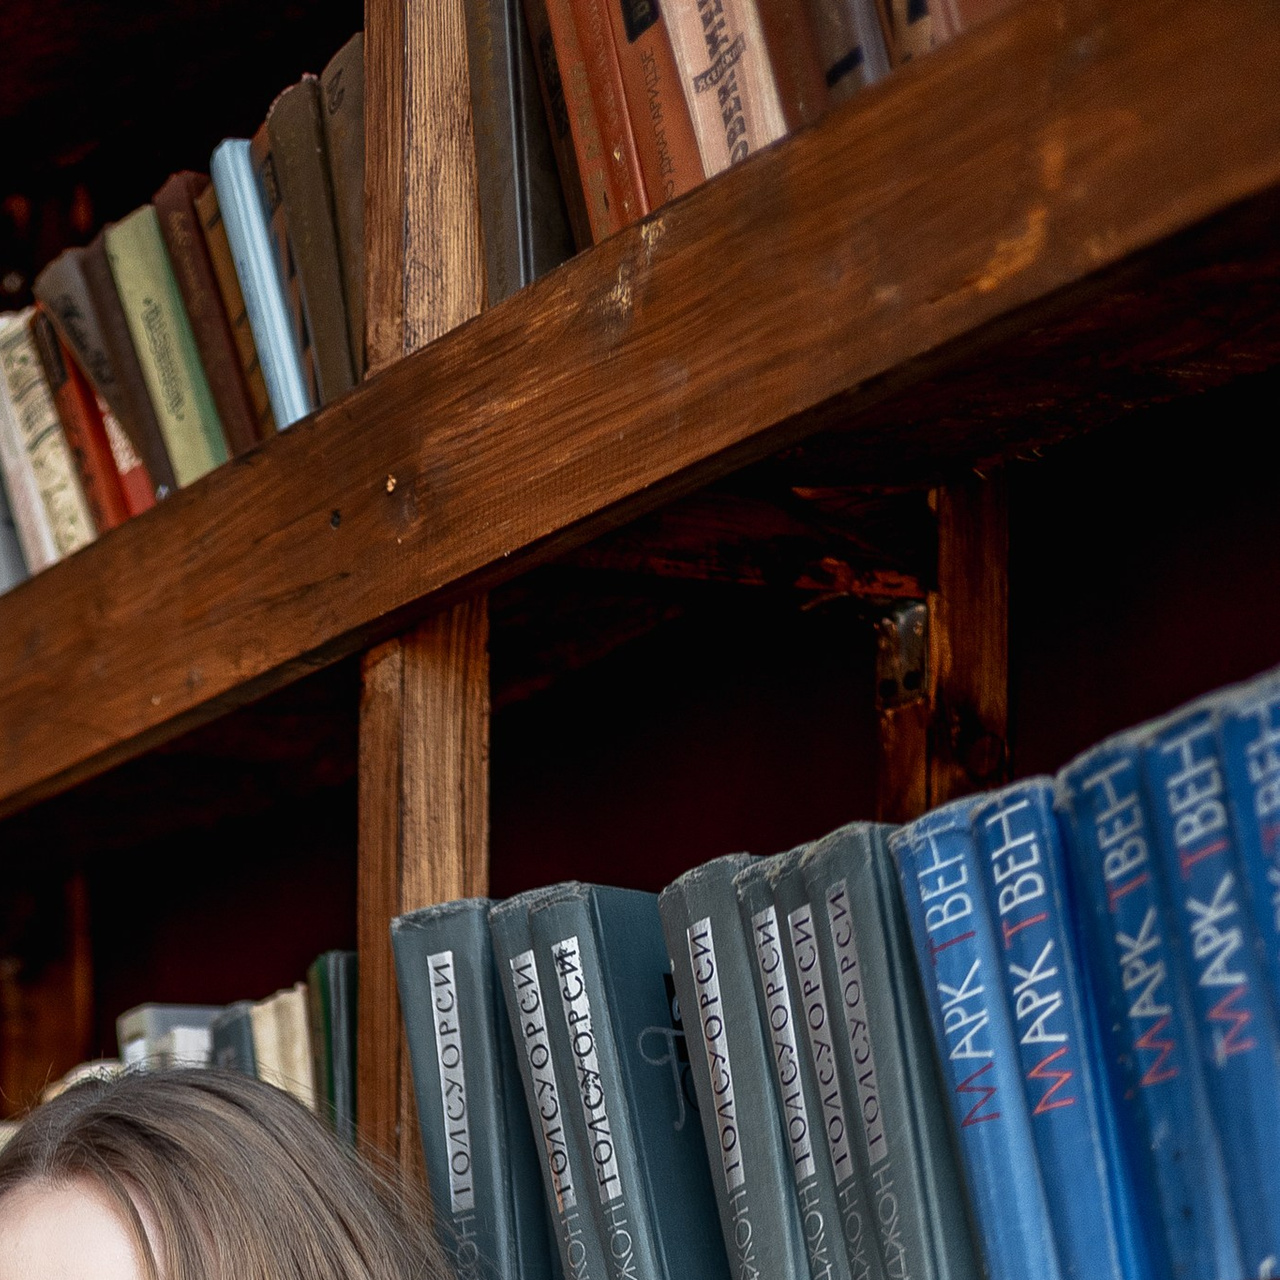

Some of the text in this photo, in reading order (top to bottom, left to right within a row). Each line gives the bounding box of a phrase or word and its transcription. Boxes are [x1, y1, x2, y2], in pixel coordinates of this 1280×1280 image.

[911, 821, 1000, 1128] МАРК ТВЕН
[985, 798, 1076, 1116] МАРК ТВЕН
[1082, 757, 1180, 1088] МАРК ТВЕН
[1161, 719, 1257, 1057] МАРК ТВЕН
[431, 963, 471, 1195] ГОЛСУОРСИ
[513, 962, 572, 1196] ГОЛСУОРСИ
[555, 949, 618, 1187] ГОЛСУОРСИ
[690, 930, 740, 1174] ГОЛСУОРСИ
[755, 919, 810, 1166] ГОЛСУОРСИ
[793, 916, 848, 1166] ГОЛСУОРСИ
[829, 889, 882, 1147] ГОЛСУОРСИ
